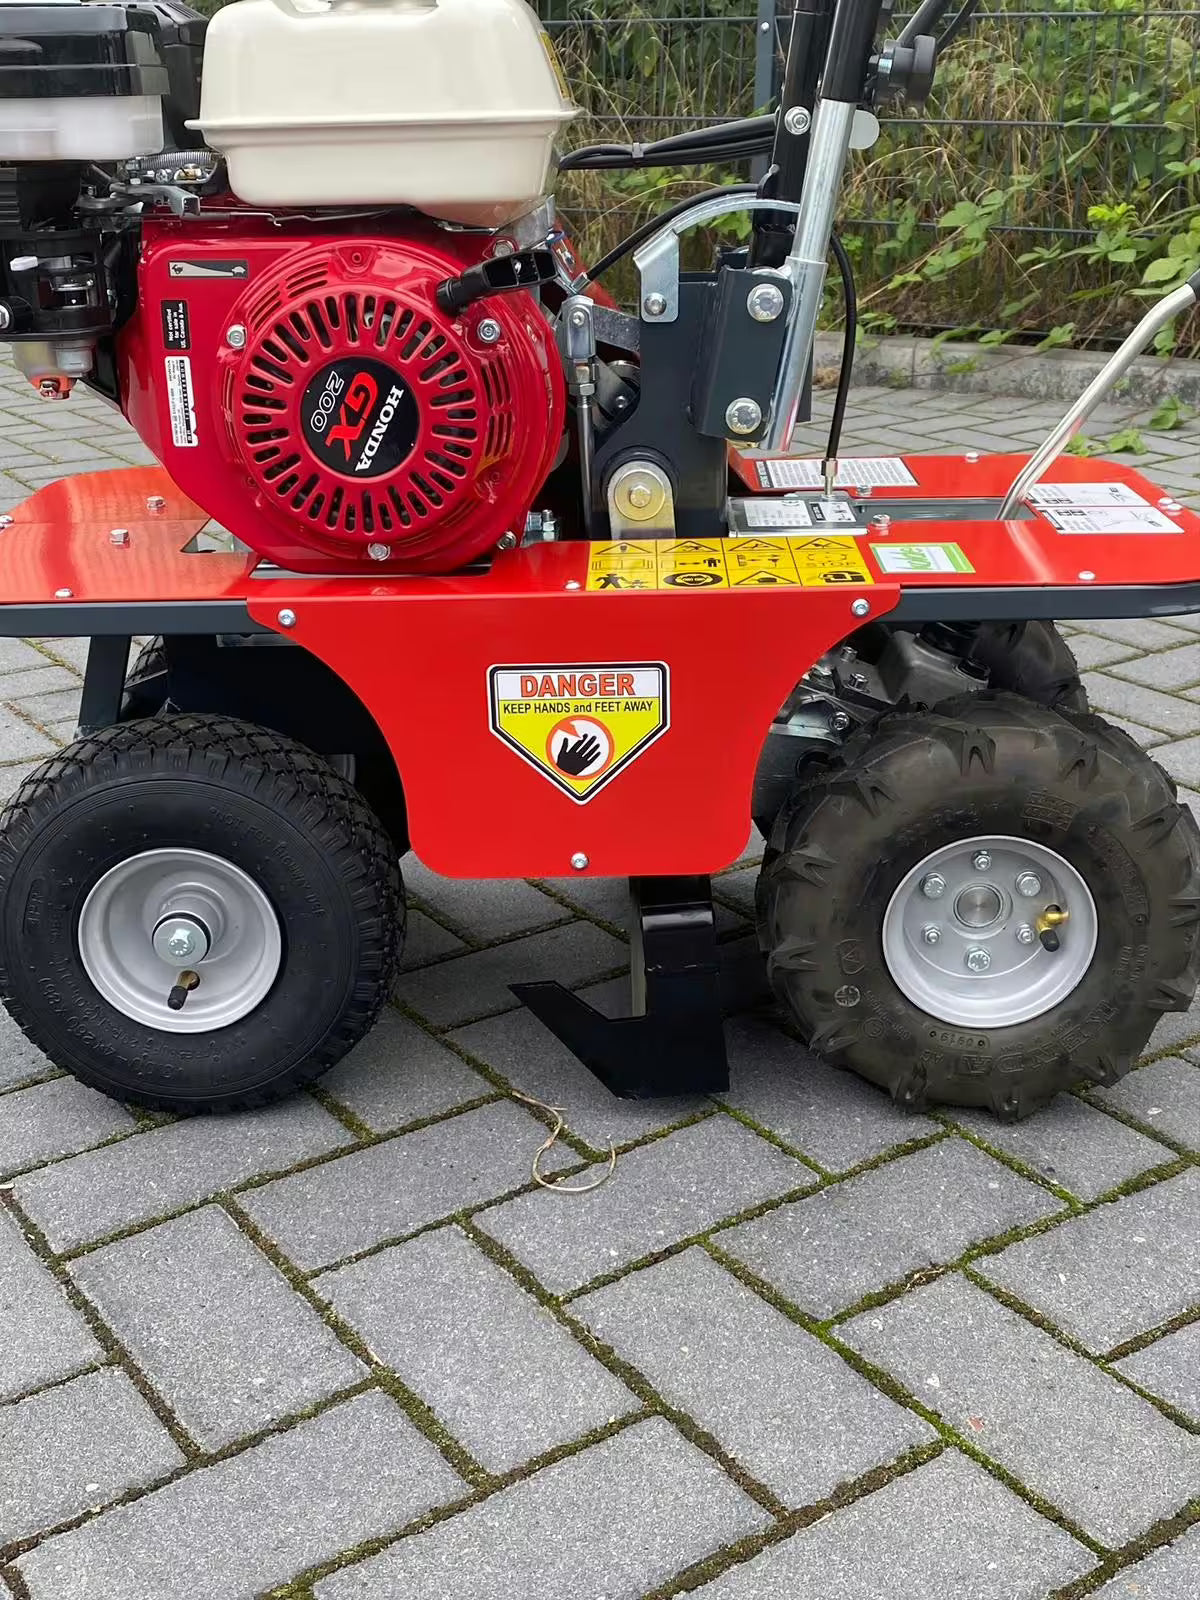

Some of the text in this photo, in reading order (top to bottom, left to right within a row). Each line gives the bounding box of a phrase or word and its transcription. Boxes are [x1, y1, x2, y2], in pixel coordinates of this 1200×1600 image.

[310, 370, 345, 433] 200
[325, 371, 379, 462] GX
[355, 385, 404, 472] HONDA
[503, 700, 653, 714] KEEP HANDS and FEET AWAY
[519, 673, 636, 698] DANGER
[961, 999, 1119, 1075] KENDA
